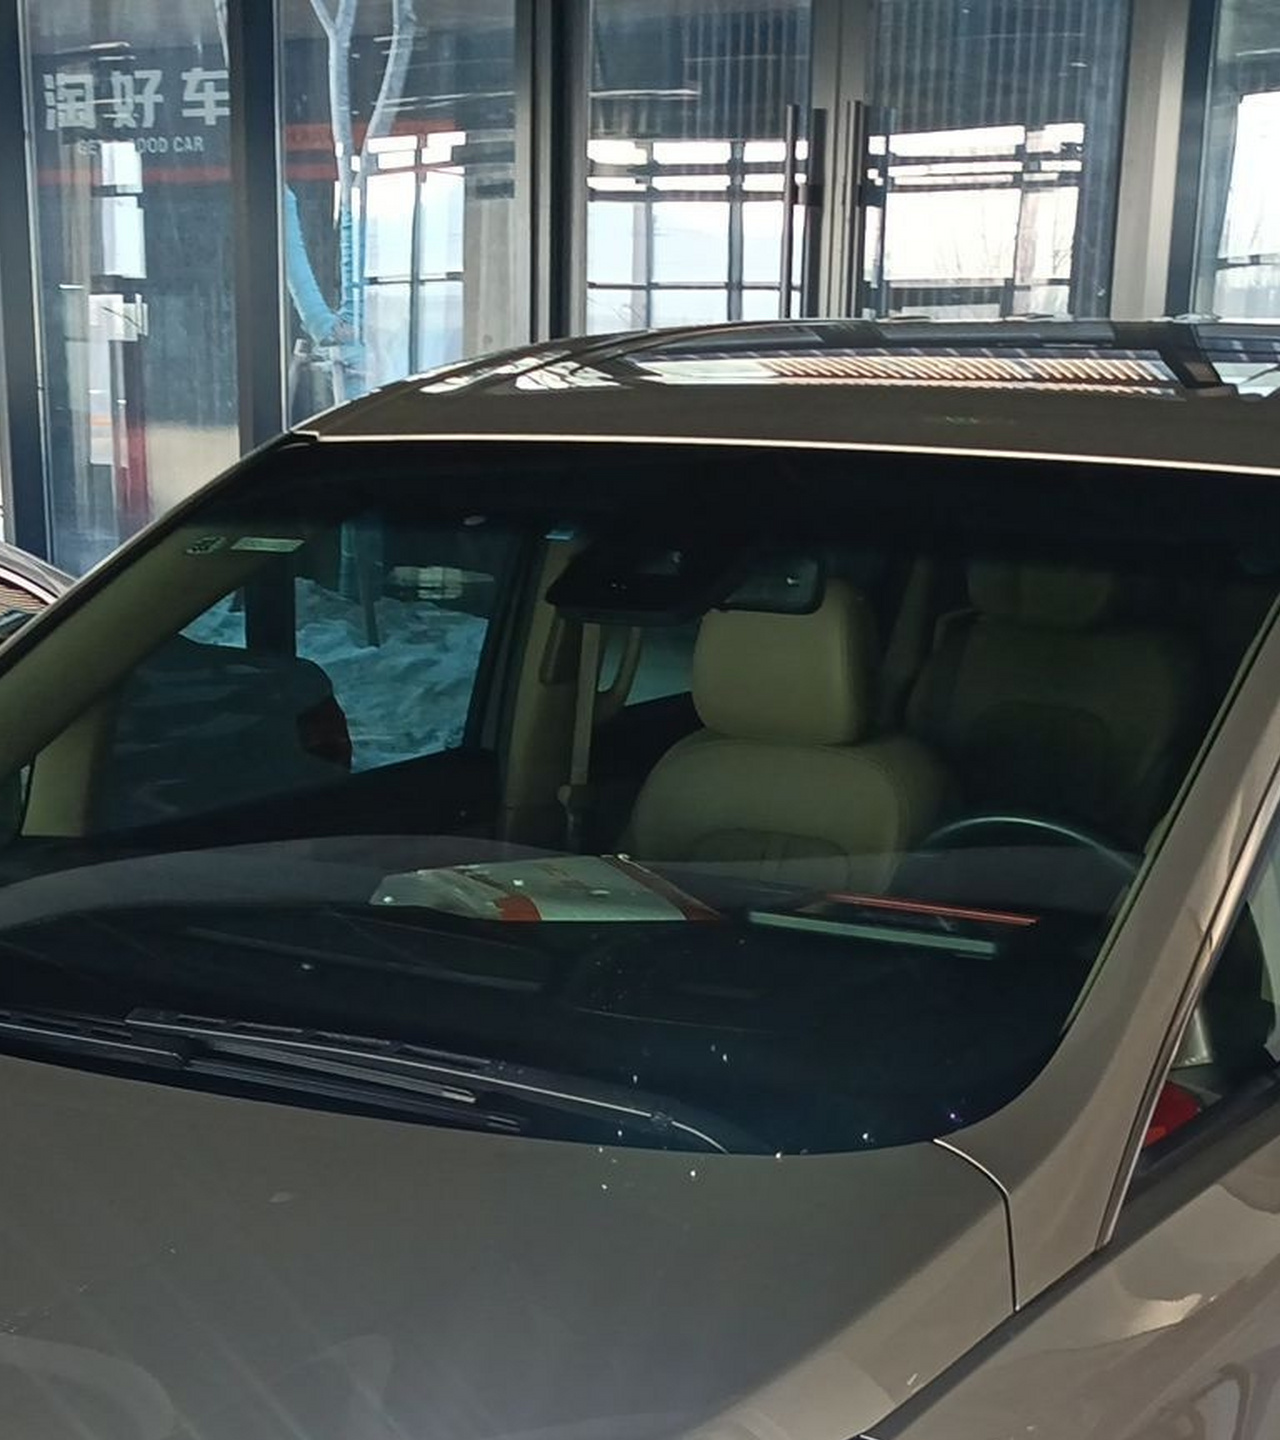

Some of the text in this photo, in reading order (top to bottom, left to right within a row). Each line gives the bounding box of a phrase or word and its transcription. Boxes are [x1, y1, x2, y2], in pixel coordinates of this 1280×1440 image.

[43, 67, 230, 131] 淘好车
[130, 136, 169, 153] OOD
[173, 135, 204, 152] CAR
